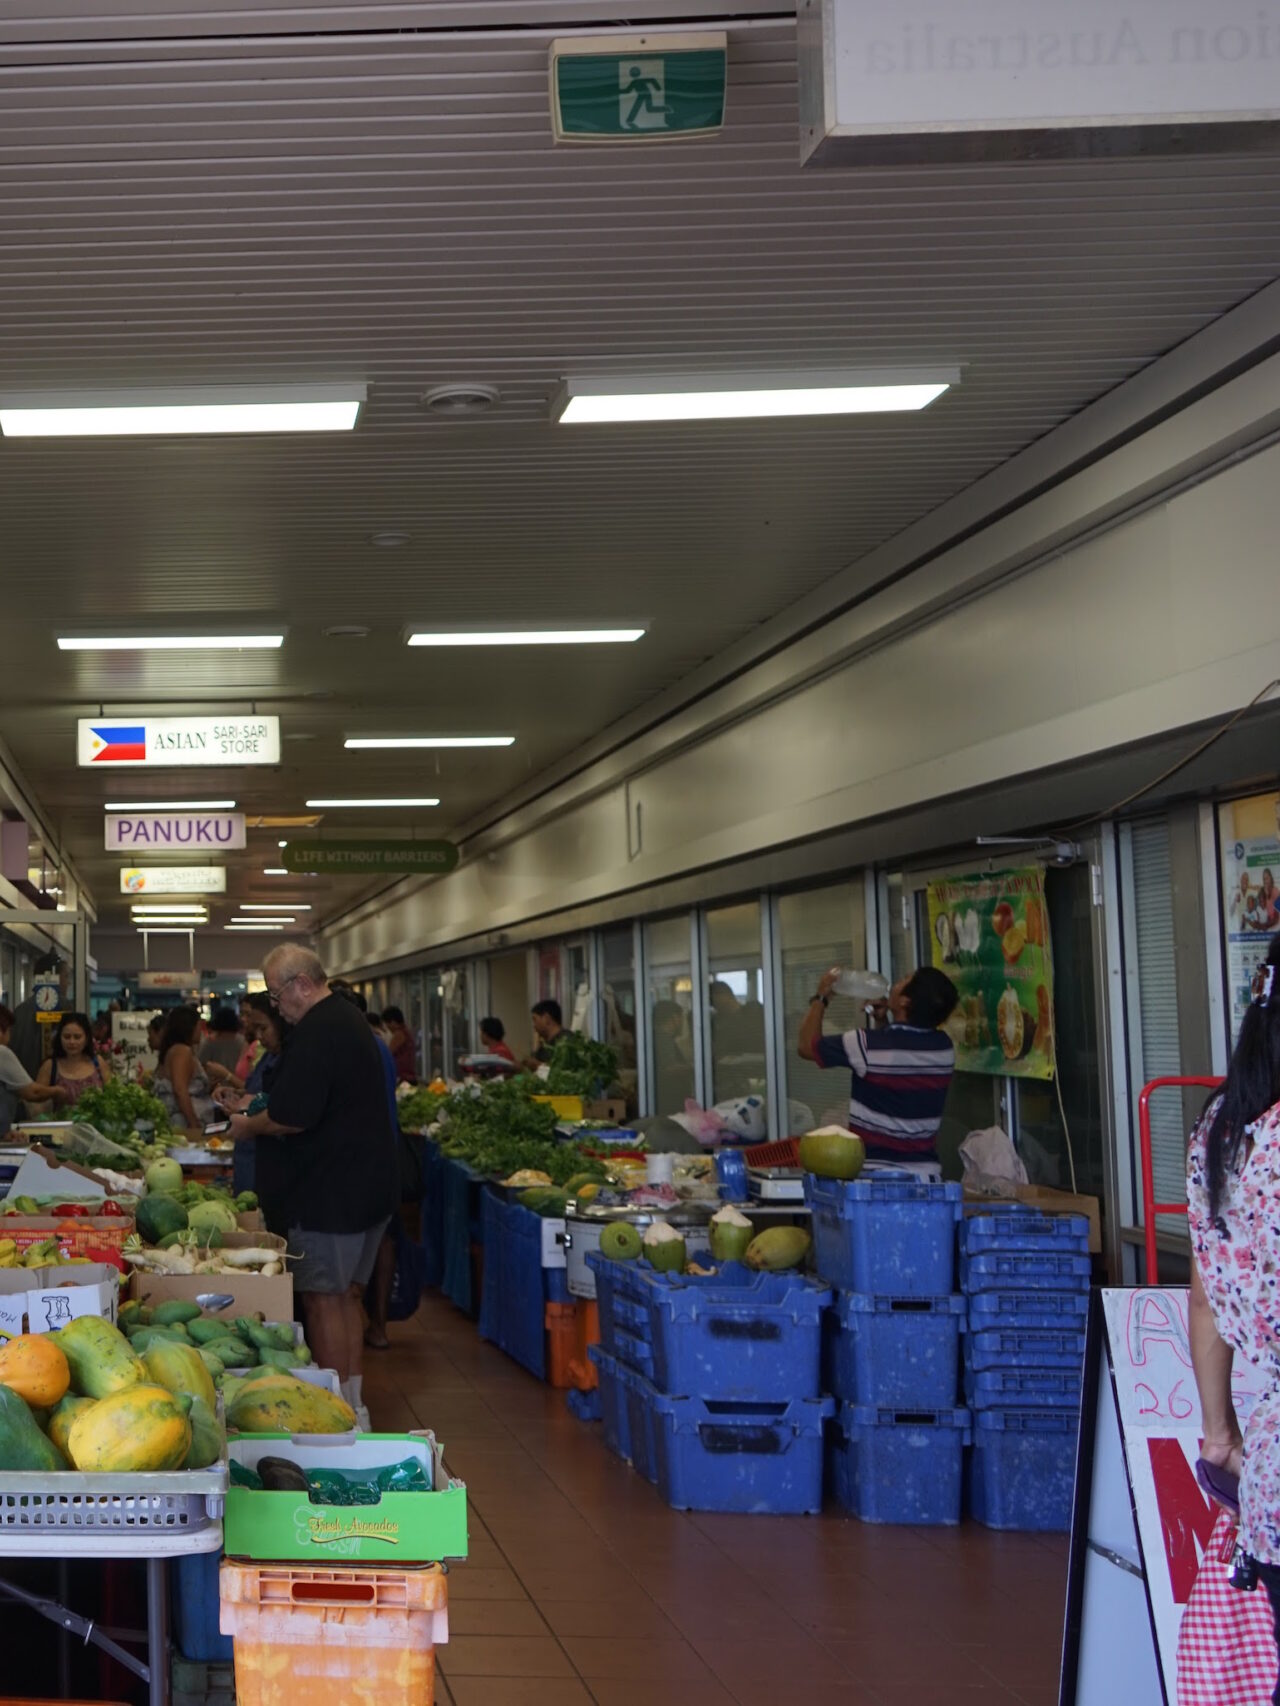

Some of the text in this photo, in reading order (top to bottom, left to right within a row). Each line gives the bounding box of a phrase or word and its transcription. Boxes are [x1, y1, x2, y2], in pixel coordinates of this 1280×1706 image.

[154, 725, 268, 749] ASIAN SARI-SARI
[221, 740, 259, 753] STORE
[117, 820, 233, 842] PANUKU
[294, 850, 447, 863] LIFE WITHOUT BARRIERS
[1134, 1380, 1193, 1419] 26
[344, 1516, 399, 1534] Avocados
